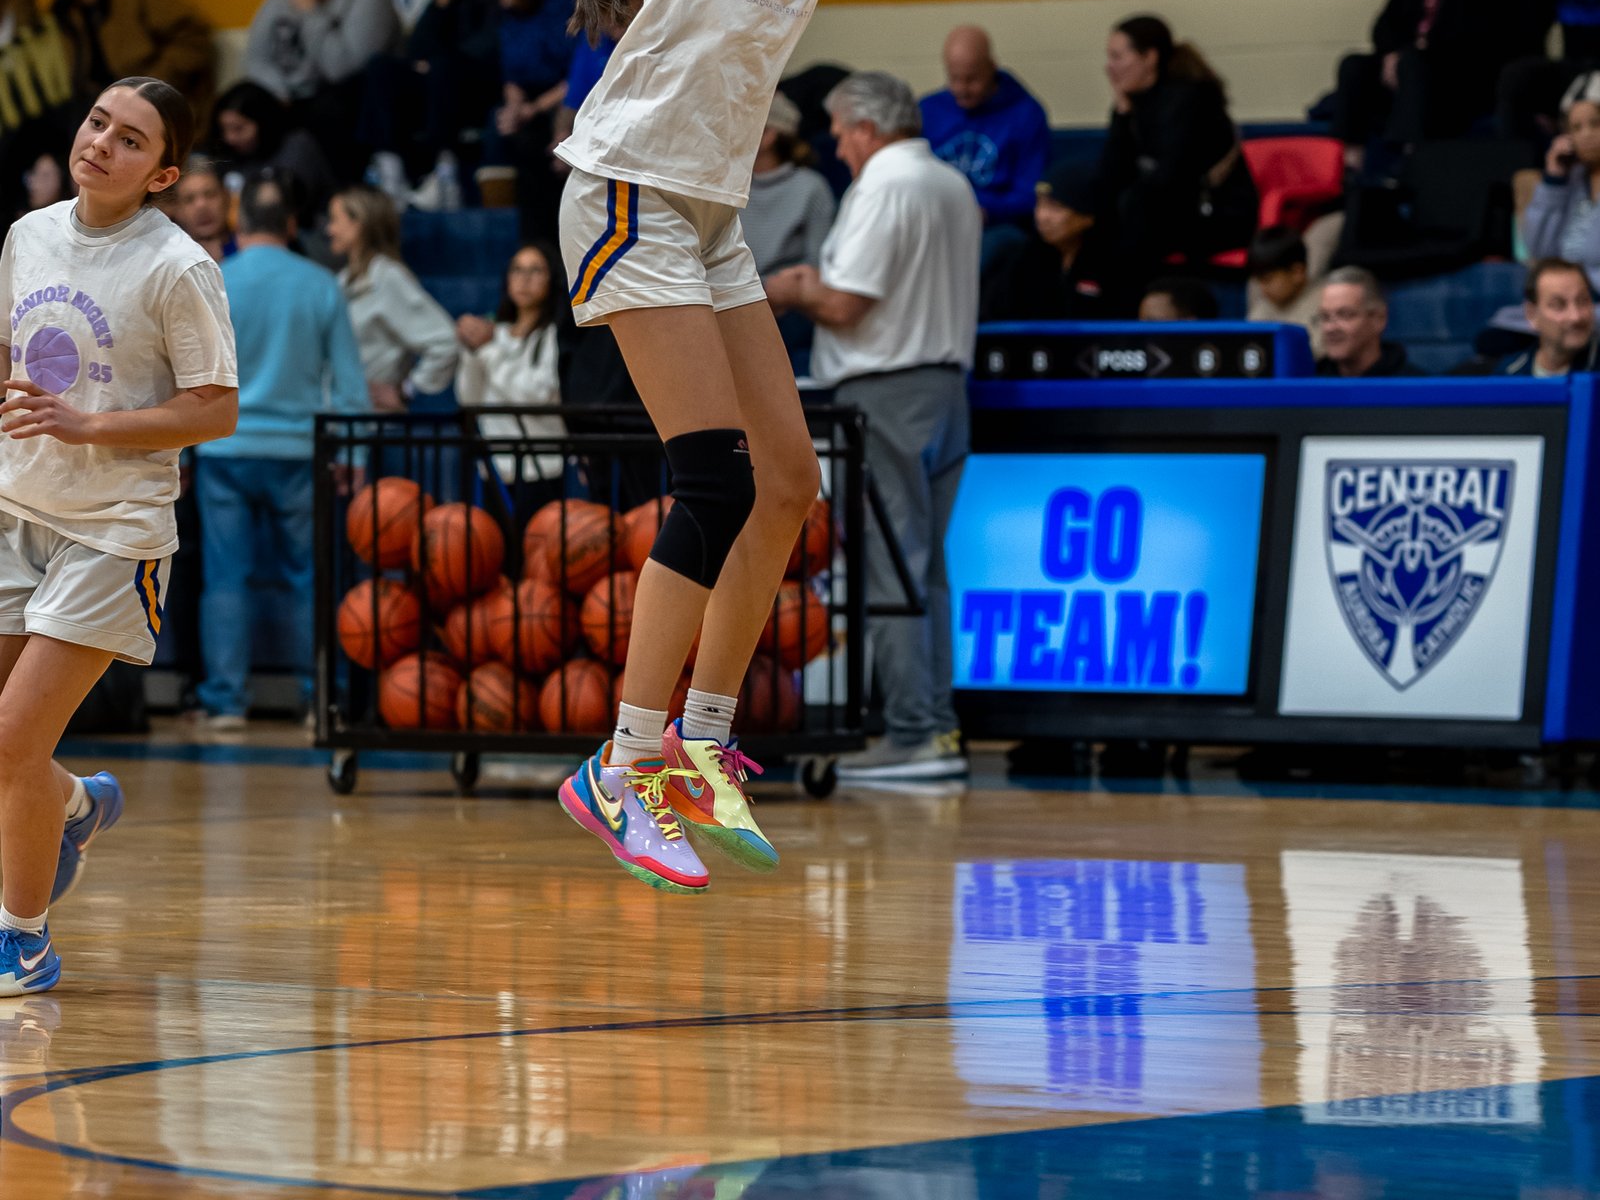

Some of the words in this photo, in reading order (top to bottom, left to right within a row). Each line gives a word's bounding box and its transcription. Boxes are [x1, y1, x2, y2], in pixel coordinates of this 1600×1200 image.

[12, 285, 70, 331] SENIOR
[71, 290, 114, 348] NIGHT
[88, 362, 112, 384] 25
[1099, 349, 1147, 372] POSS
[1332, 466, 1504, 519] CENTRAL
[1040, 485, 1143, 584] GO
[961, 590, 1208, 689] TEAM!
